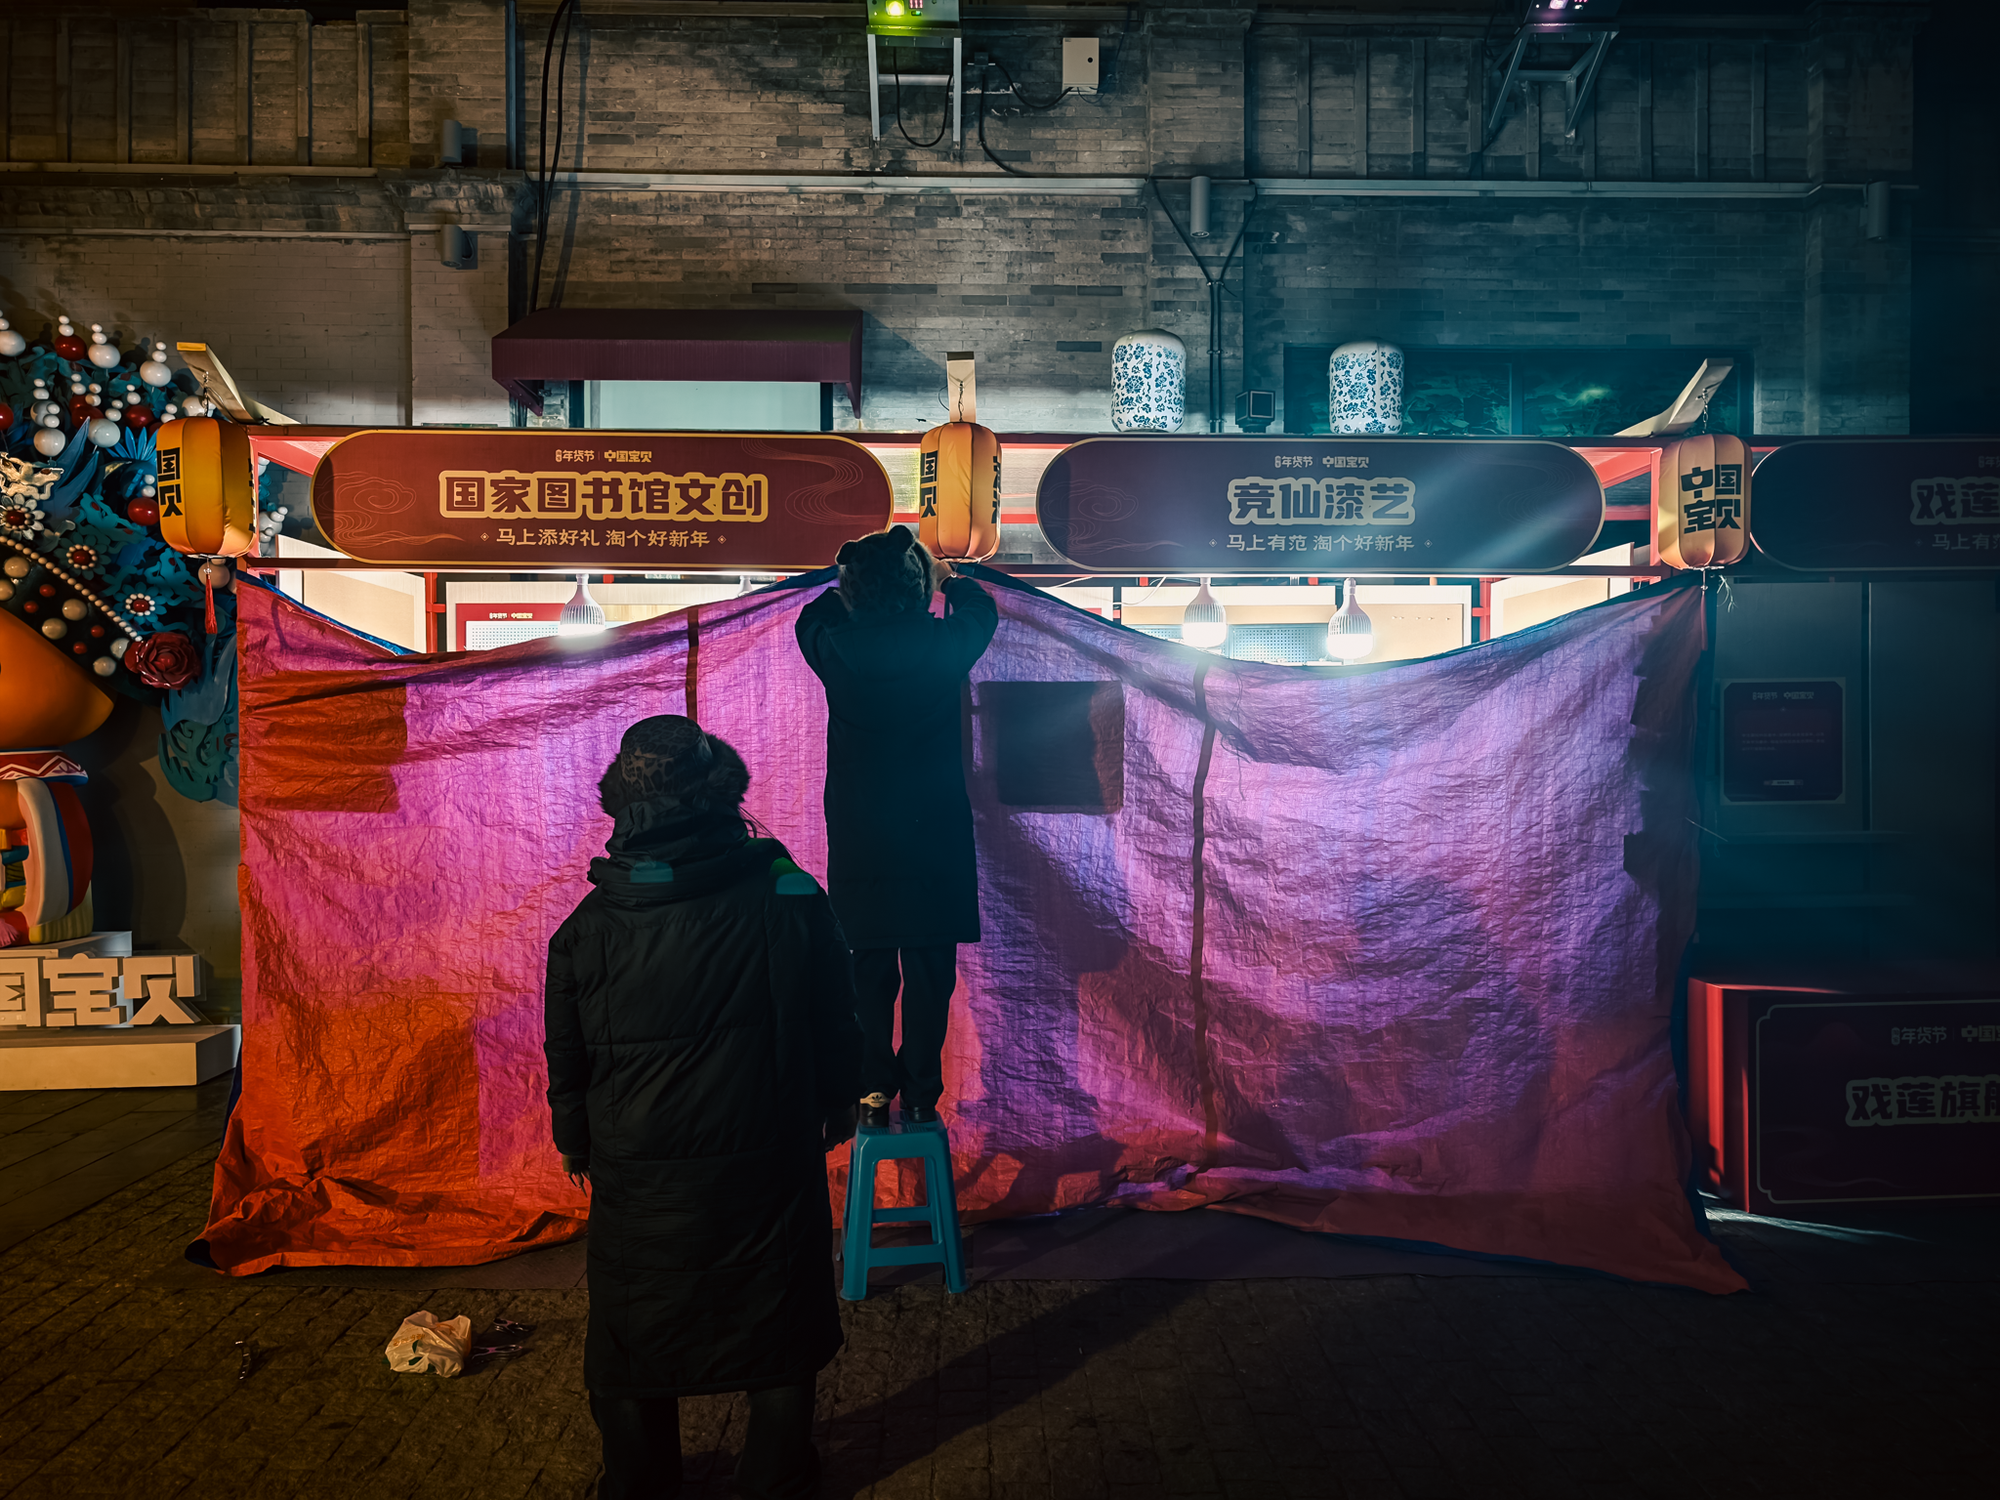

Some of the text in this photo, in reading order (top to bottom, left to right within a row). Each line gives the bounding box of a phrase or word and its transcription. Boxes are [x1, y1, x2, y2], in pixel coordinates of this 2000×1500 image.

[603, 449, 653, 463] 中国宝贝
[1322, 455, 1370, 468] 中国宝贝
[443, 473, 765, 519] 国家图书馆文创
[1231, 479, 1412, 522] 竞仙漆艺
[496, 528, 710, 548] 马上添好礼 淘个好新年
[1226, 534, 1415, 552] 马上有范 淘个好新年
[1961, 1025, 2000, 1043] 中国
